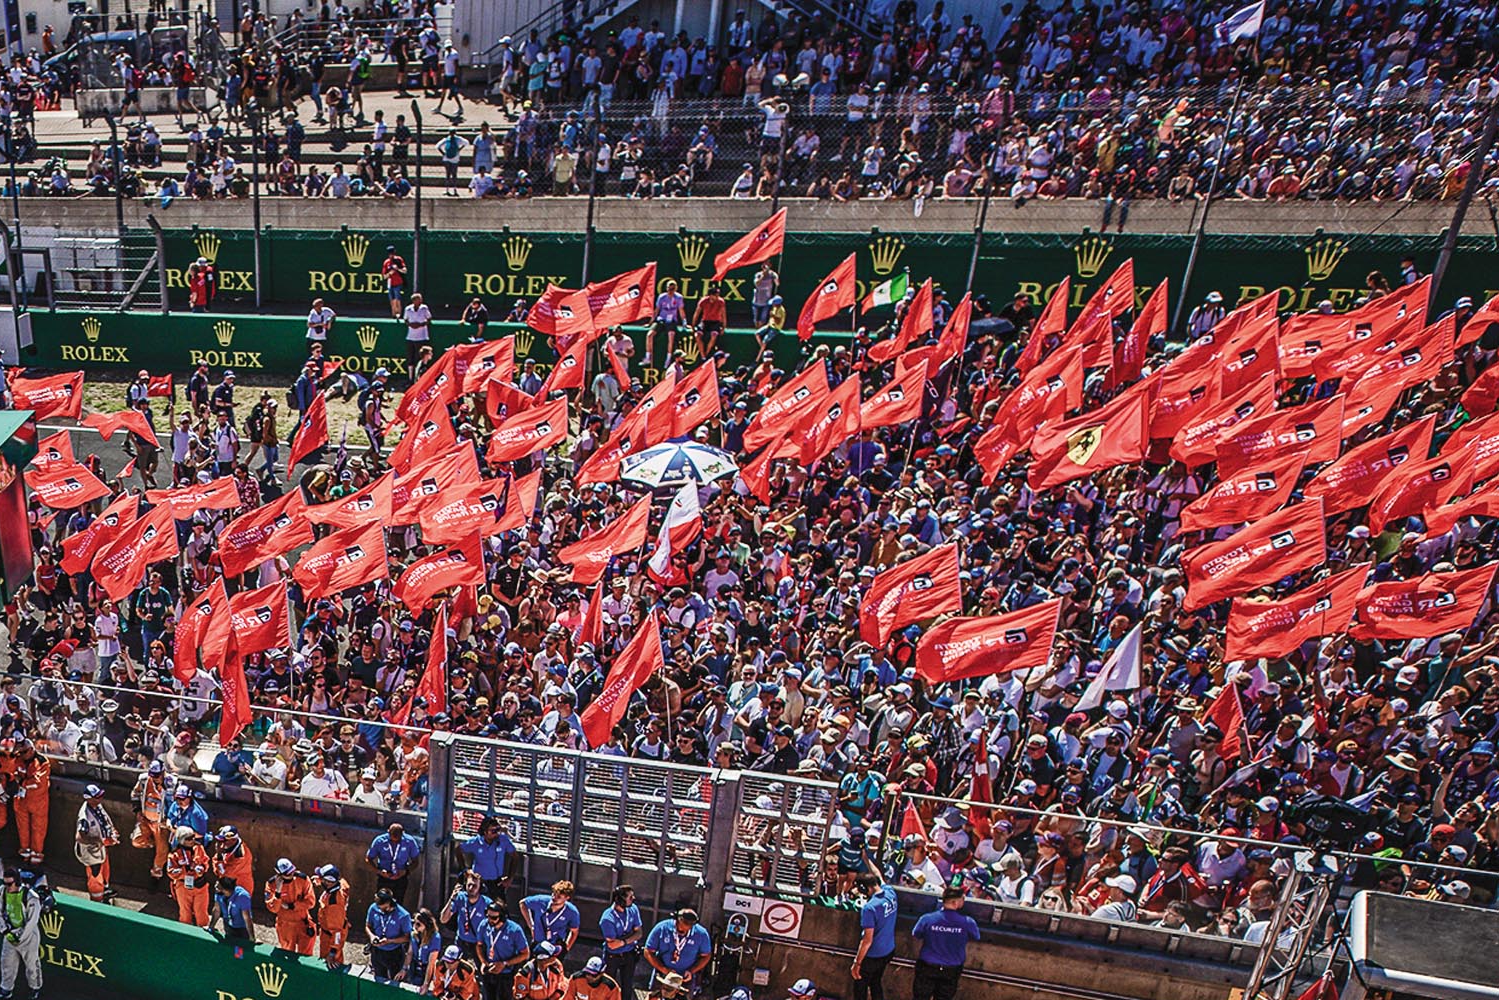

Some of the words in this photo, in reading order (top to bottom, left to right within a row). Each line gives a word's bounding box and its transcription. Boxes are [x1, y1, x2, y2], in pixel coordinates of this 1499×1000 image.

[166, 268, 255, 292] REX
[308, 270, 403, 293] ROLE
[61, 345, 130, 362] ROLEX
[190, 350, 262, 368] ROLEX
[735, 899, 751, 908] DC1
